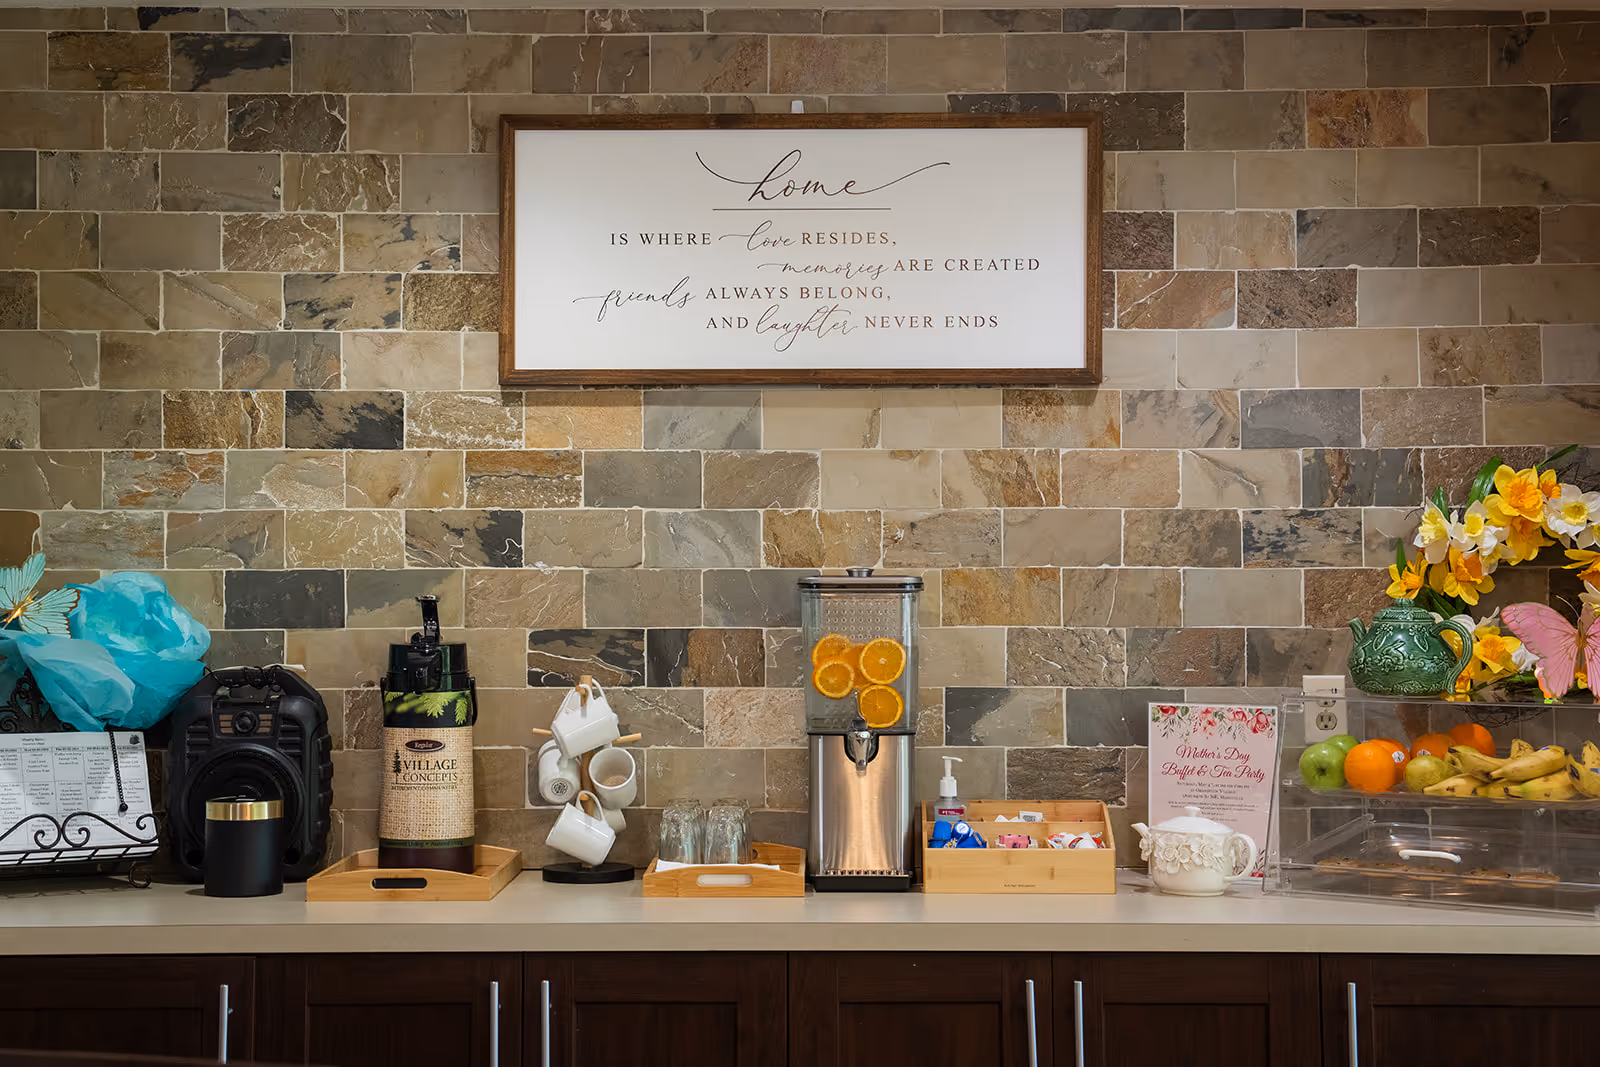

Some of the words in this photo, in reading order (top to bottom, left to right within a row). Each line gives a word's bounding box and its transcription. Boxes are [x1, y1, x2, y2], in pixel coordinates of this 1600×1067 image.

[696, 149, 950, 202] home
[610, 232, 629, 246] IS
[639, 232, 712, 246] WHERE
[718, 220, 796, 251] love
[801, 232, 897, 248] RESIDES,
[757, 261, 887, 280] memories
[893, 258, 934, 272] ARE
[944, 258, 1040, 273] CREATED
[573, 276, 697, 322] friends
[705, 286, 789, 300] ALWAYS
[799, 286, 891, 301] BELONG,
[706, 316, 749, 330] AND
[756, 304, 857, 352] laughter
[864, 315, 934, 329] NEVER
[944, 315, 998, 329] ENDS
[403, 759, 458, 770] VILLAGE
[1175, 744, 1222, 760] Mother's
[1223, 746, 1251, 764] Day
[403, 772, 458, 782] CONCEPTS
[1161, 761, 1196, 780] Buffet
[1196, 764, 1208, 777] &
[1209, 764, 1232, 779] Tea
[1234, 764, 1265, 783] Party
